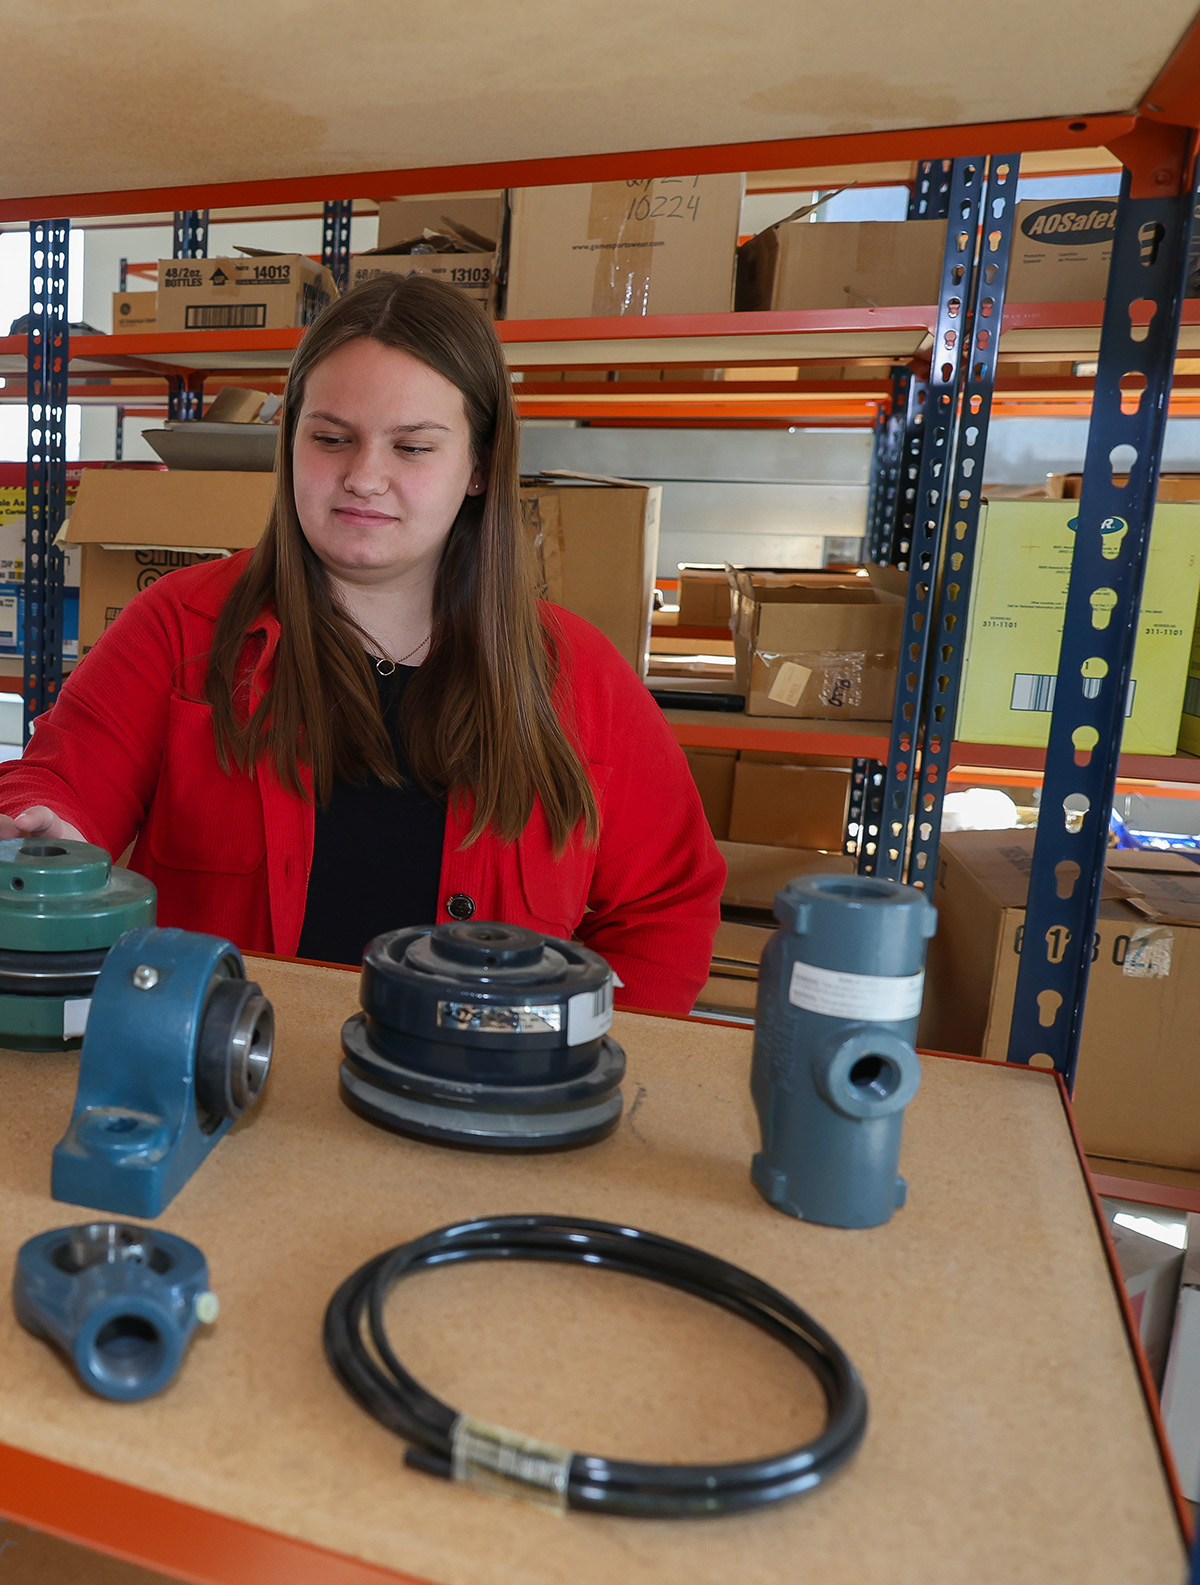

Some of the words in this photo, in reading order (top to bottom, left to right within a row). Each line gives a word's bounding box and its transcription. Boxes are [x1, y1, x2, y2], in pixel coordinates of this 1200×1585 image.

[627, 195, 700, 221] 10224
[1028, 208, 1118, 236] AOSafet
[253, 265, 290, 279] 14013
[450, 268, 490, 282] 13103
[165, 278, 203, 287] BOTTLES
[12, 499, 25, 507] As
[983, 620, 1017, 629] 311-1101
[1145, 628, 1183, 636] 311-1101
